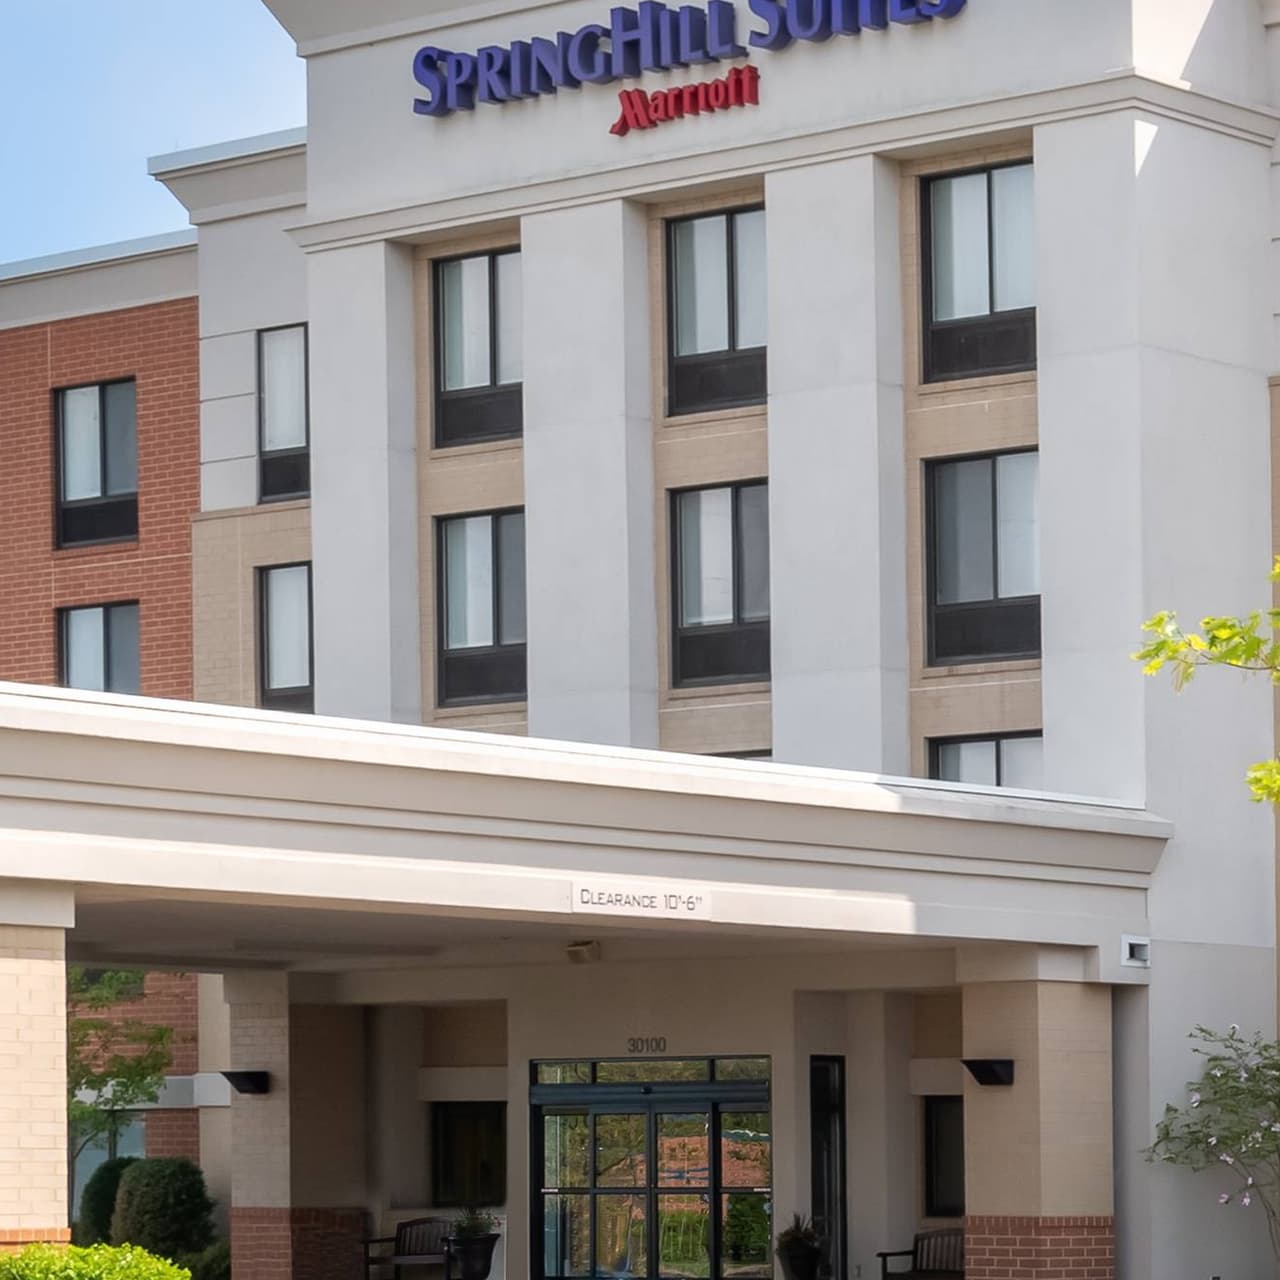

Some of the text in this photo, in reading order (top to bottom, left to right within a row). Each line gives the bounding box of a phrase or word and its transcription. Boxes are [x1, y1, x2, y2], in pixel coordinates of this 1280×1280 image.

[412, 0, 750, 117] SPRINGHILL
[609, 64, 760, 137] Marriott
[580, 888, 658, 909] CLEARANCE
[627, 1036, 666, 1053] 30100
